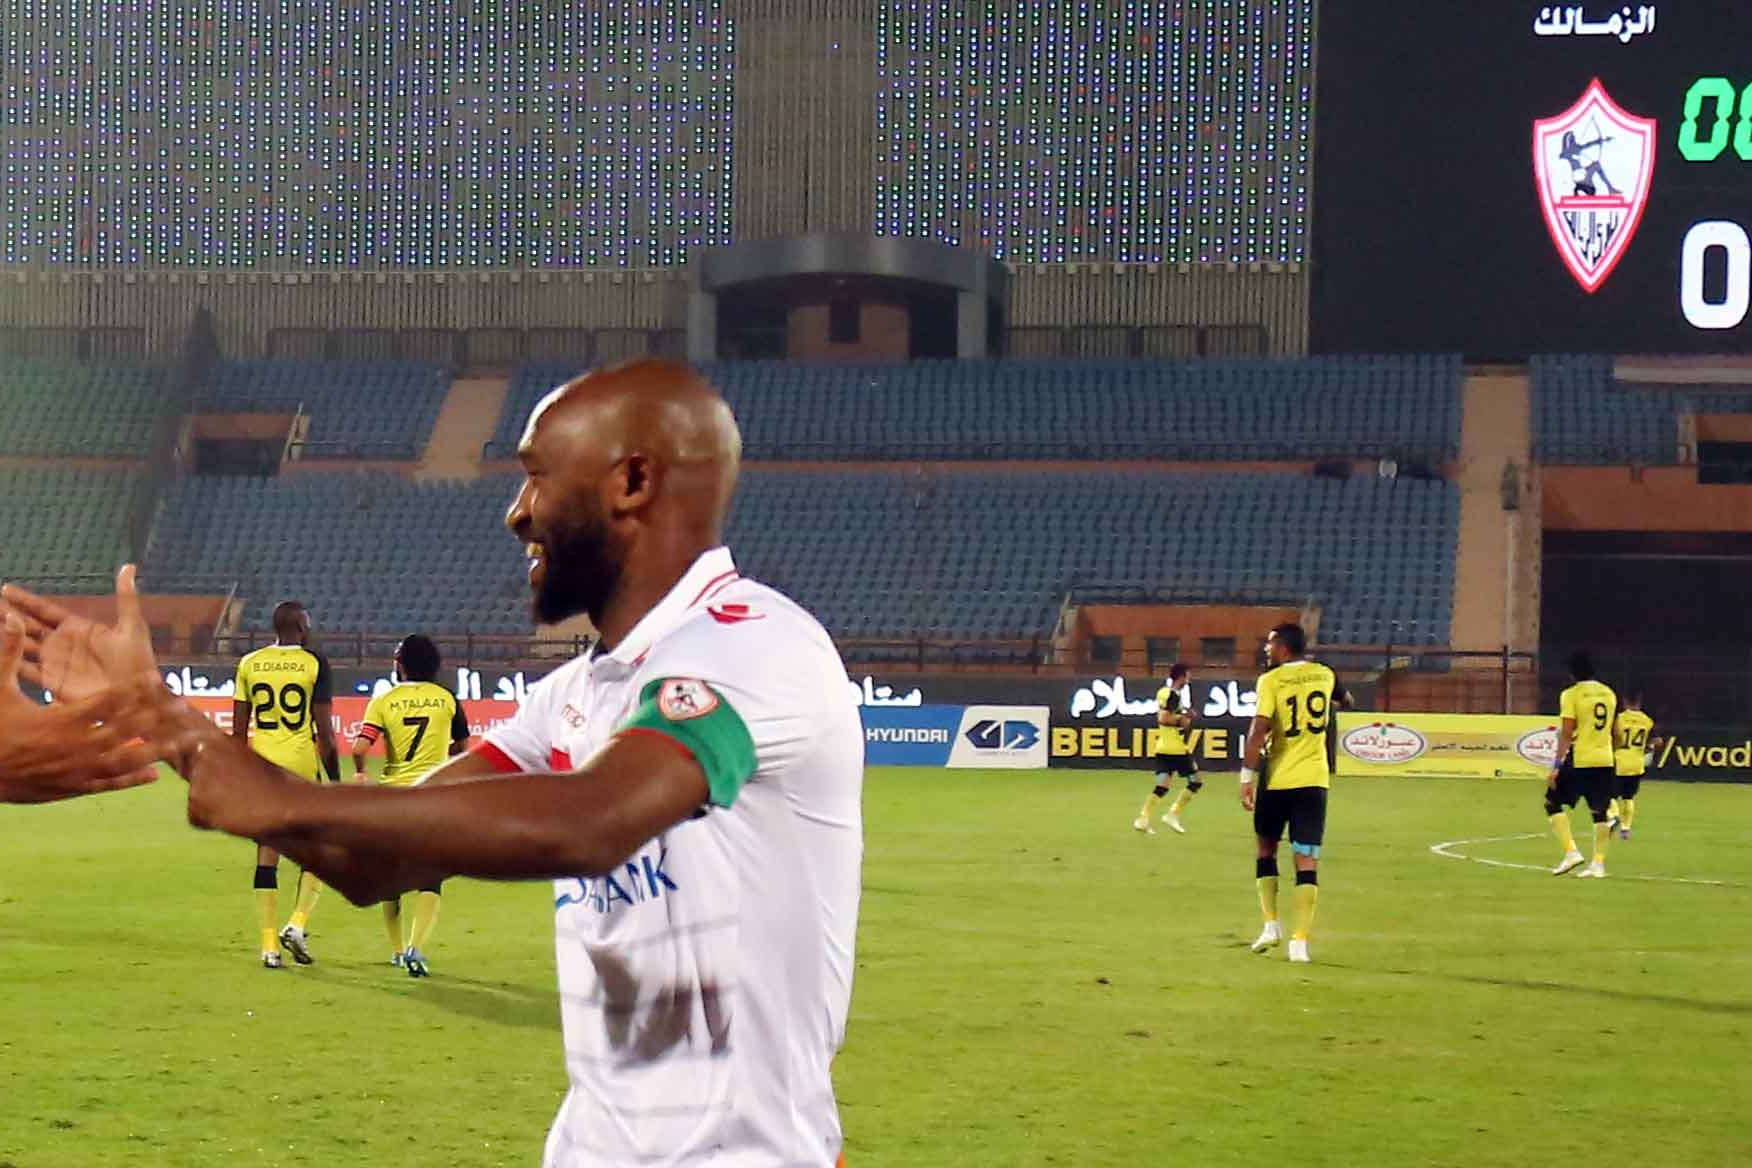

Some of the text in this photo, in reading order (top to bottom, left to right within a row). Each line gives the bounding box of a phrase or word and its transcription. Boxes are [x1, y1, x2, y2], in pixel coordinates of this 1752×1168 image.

[1533, 4, 1656, 43] الزمالك
[1680, 219, 1751, 329] 0
[251, 682, 307, 731] 29
[1284, 690, 1327, 737] 19
[1593, 702, 1608, 731] 9
[402, 716, 430, 762] 7
[866, 727, 949, 744] HYUNDAI
[1621, 728, 1646, 749] 14
